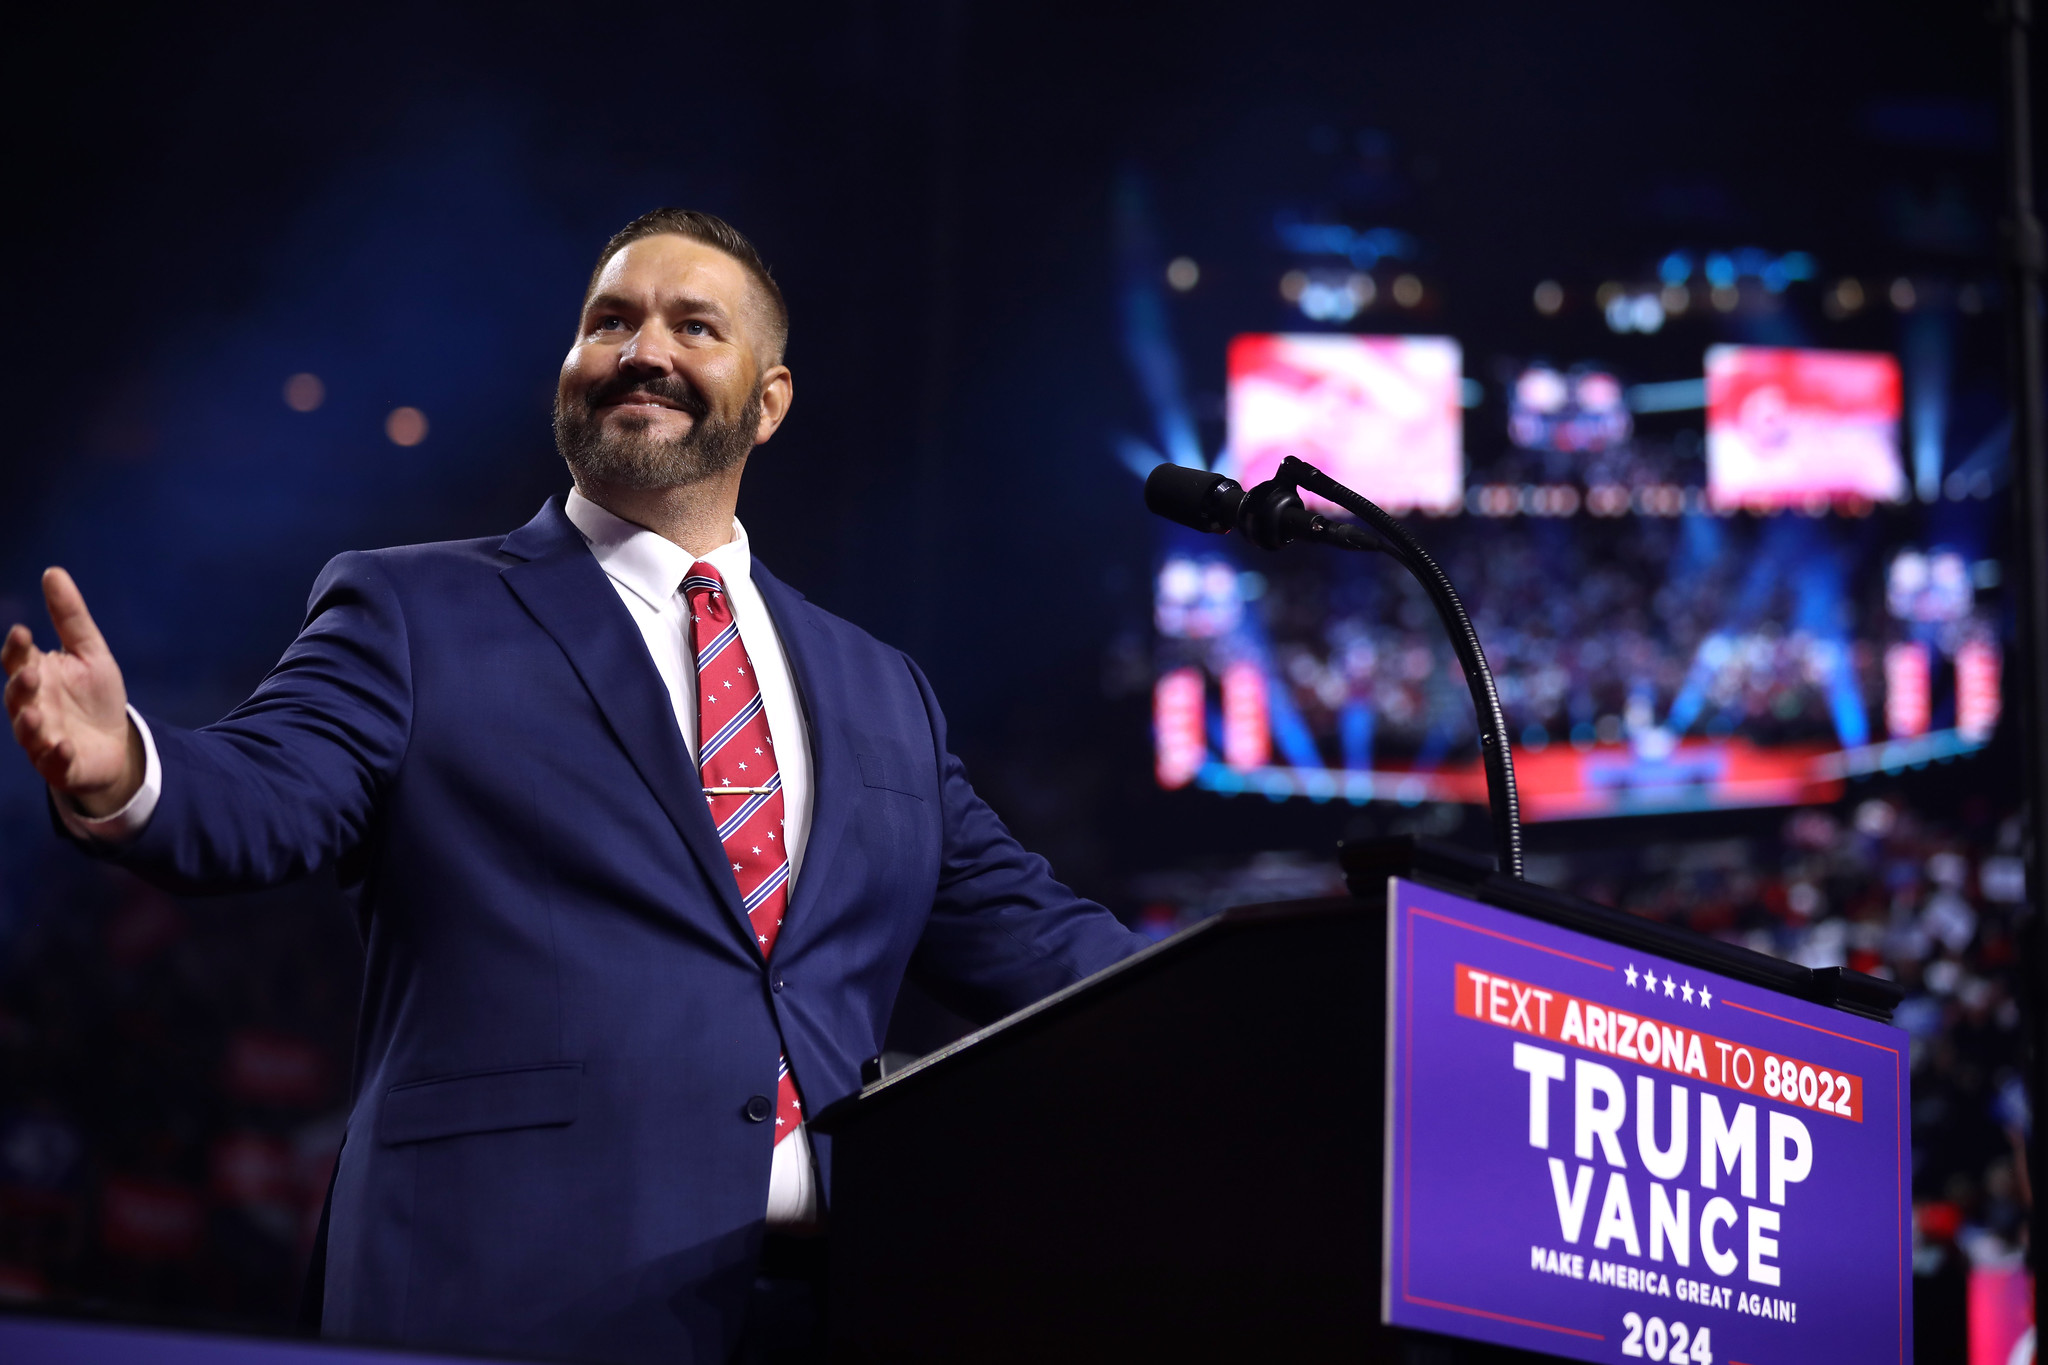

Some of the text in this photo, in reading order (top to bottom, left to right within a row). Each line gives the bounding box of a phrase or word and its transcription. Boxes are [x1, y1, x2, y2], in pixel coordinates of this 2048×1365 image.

[1467, 970, 1852, 1117] TEXT ARIZONA TO 88022
[1512, 1041, 1814, 1207] TRUMP
[1530, 1245, 1797, 1324] MAKE AMERICA GREAT AGAIN!
[1547, 1157, 1781, 1287] VANCE
[1621, 1311, 1713, 1365] 2024
